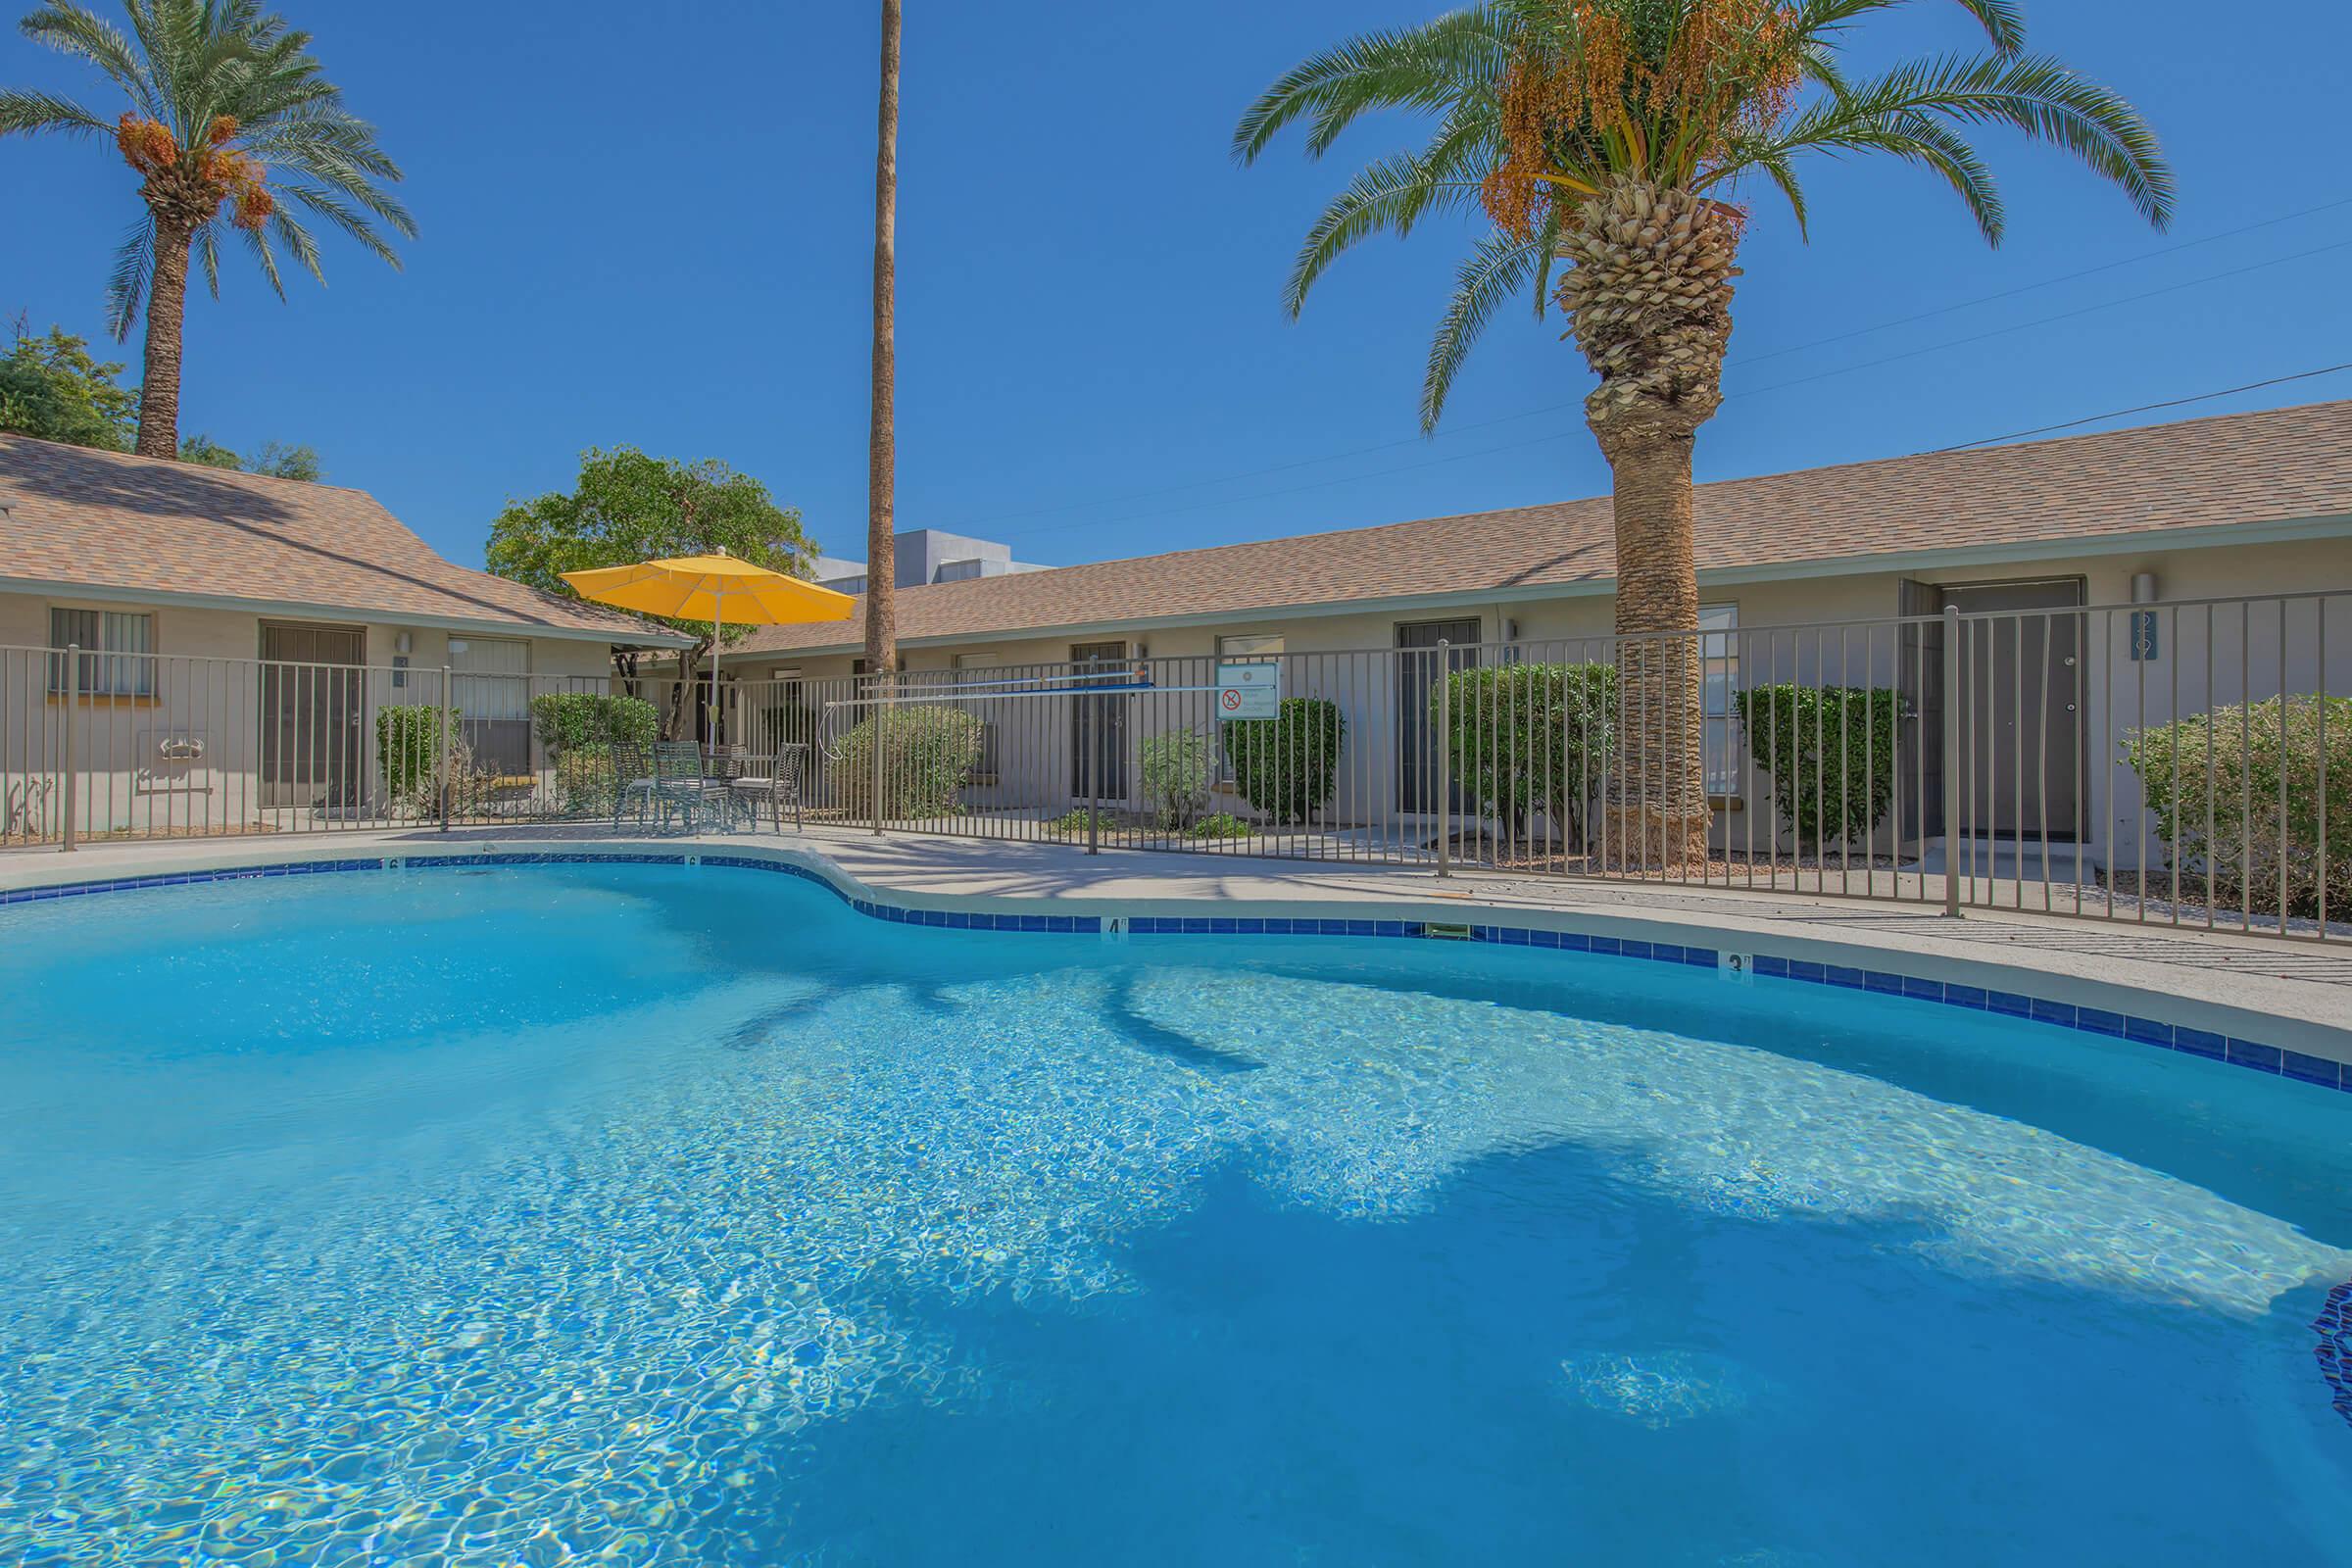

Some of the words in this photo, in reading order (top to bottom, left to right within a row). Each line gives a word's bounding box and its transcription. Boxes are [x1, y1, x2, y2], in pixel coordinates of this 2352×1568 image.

[2136, 614, 2152, 660] 29
[1107, 918, 1119, 934] 4
[1729, 954, 1742, 971] 3
